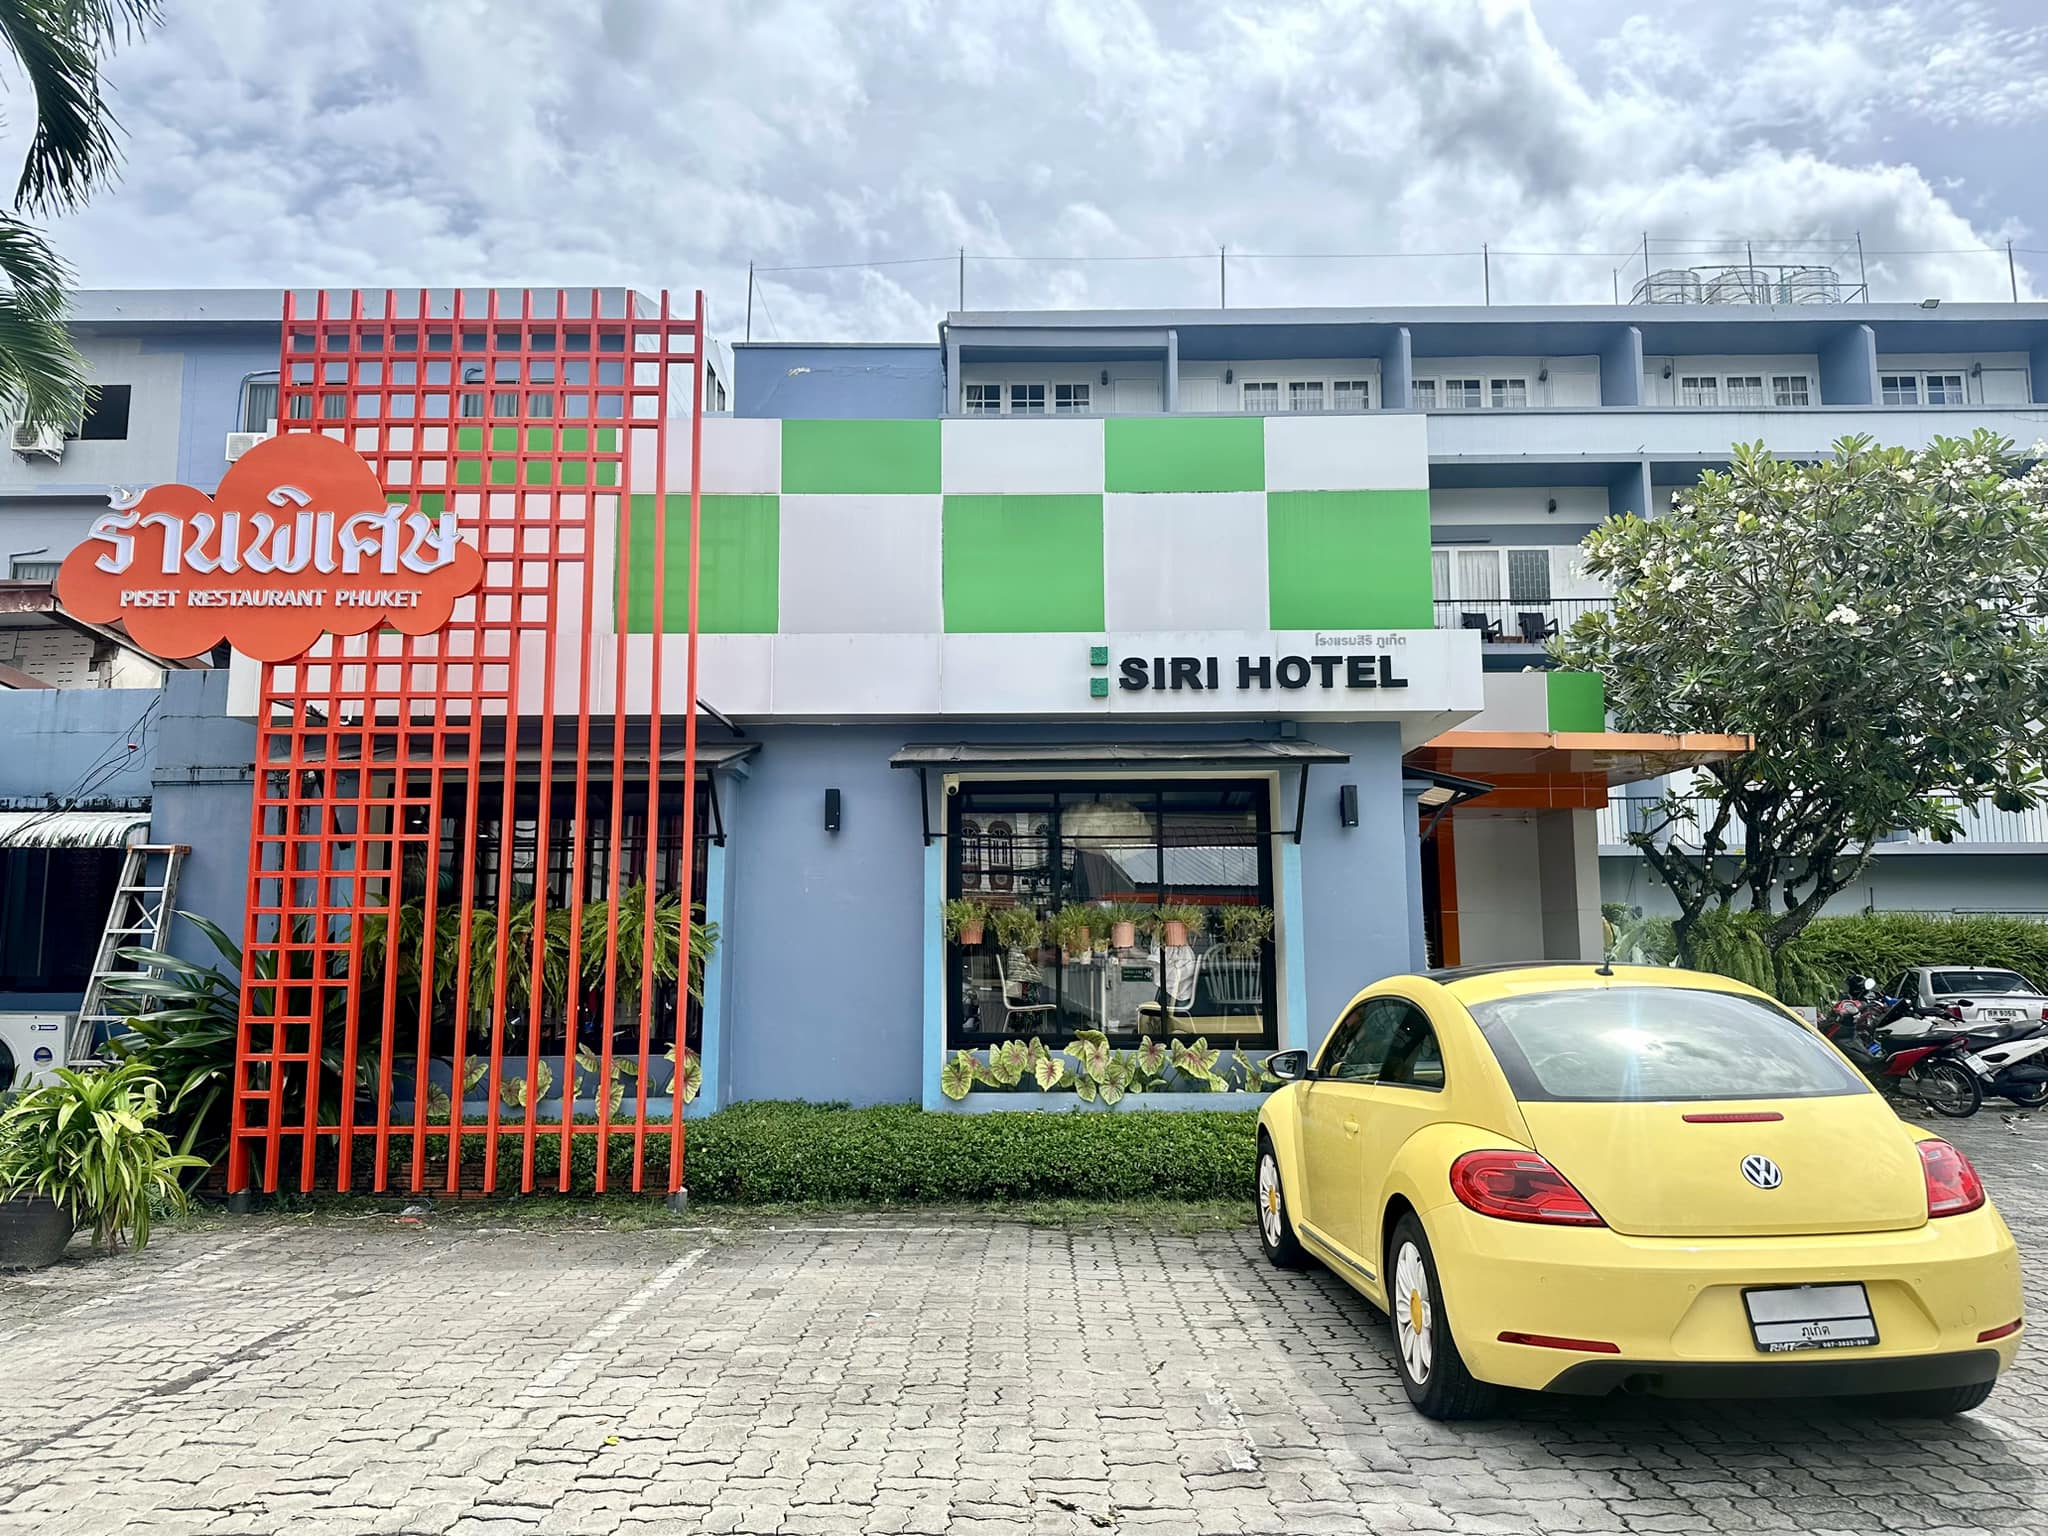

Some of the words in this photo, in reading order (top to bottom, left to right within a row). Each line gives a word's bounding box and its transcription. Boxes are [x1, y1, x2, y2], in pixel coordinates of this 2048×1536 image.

[88, 485, 463, 575] ร้านพิเศษ
[120, 589, 180, 607] PISET
[188, 589, 327, 607] RESTAURANT
[335, 589, 422, 608] PHUKET
[1375, 633, 1407, 649] ภูเก็ต
[1119, 656, 1219, 690] SIRI
[1236, 655, 1409, 689] HOTEL
[1801, 1321, 1831, 1340] ภูเก็ต
[1769, 1342, 1796, 1352] RMT
